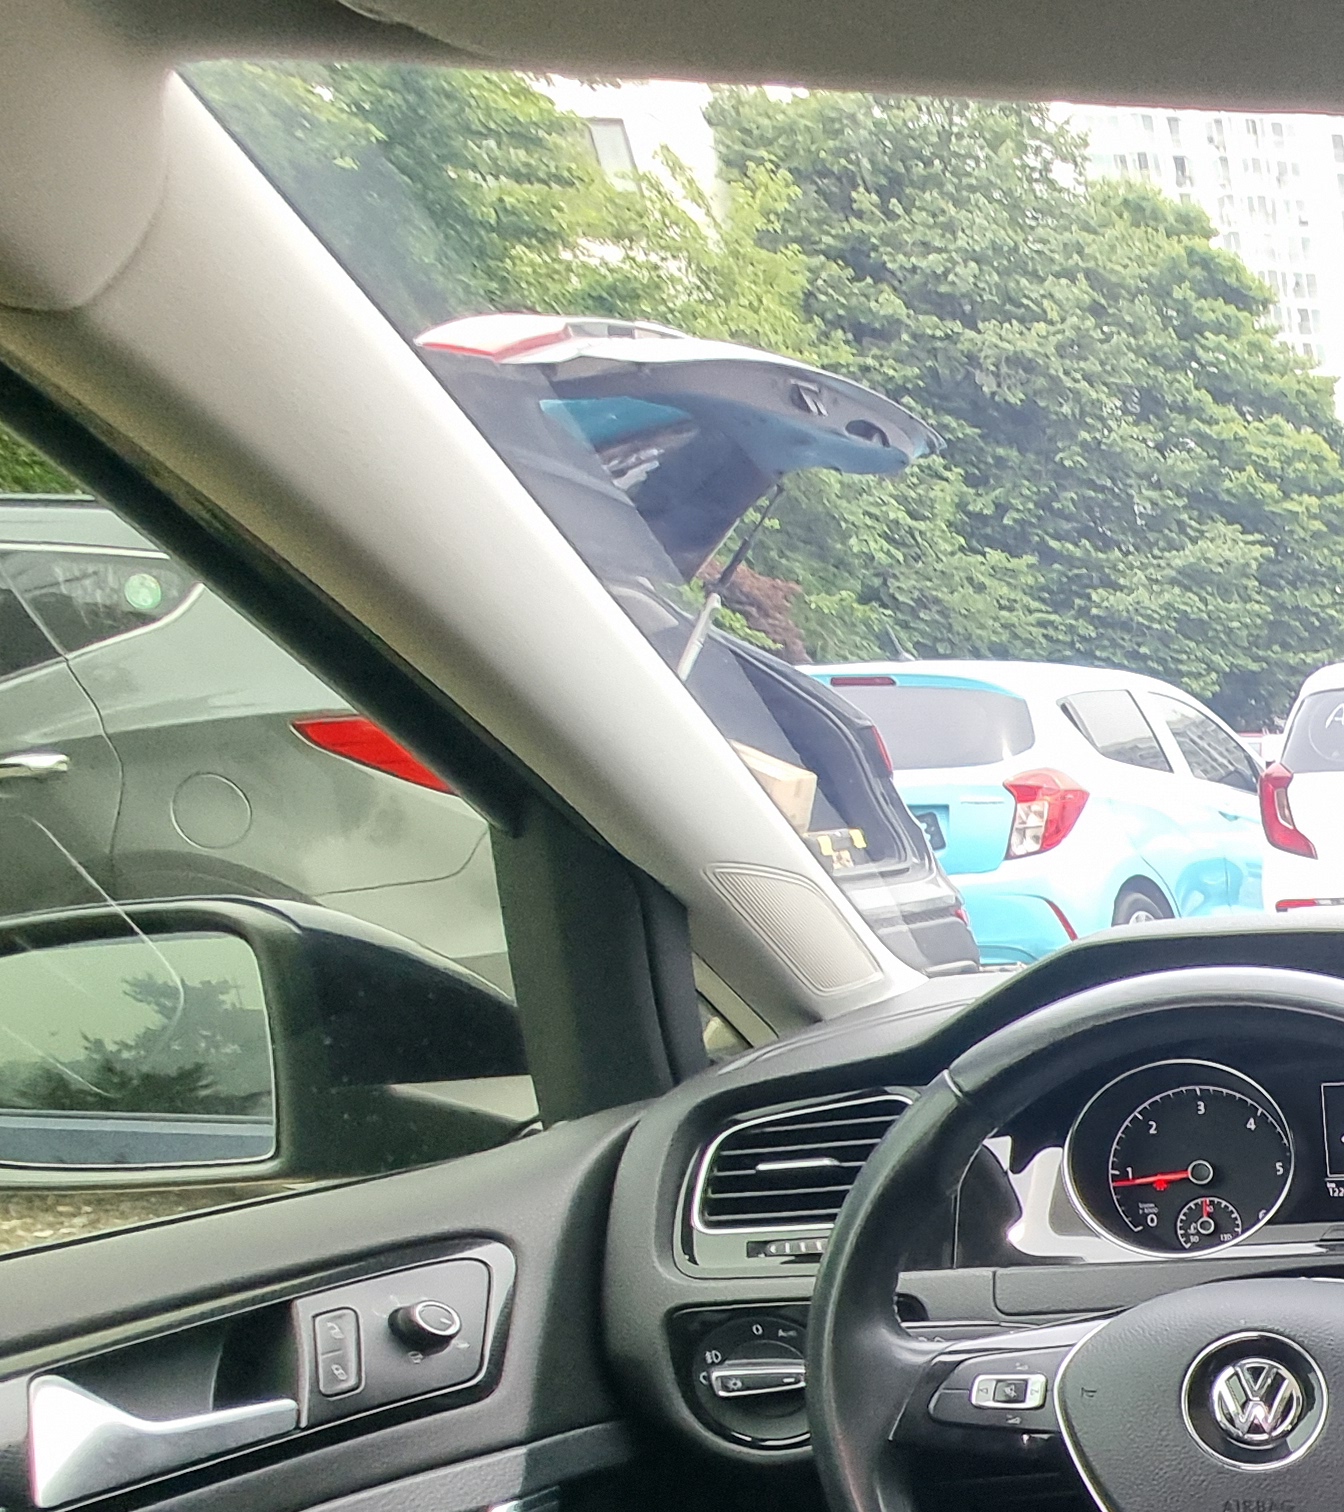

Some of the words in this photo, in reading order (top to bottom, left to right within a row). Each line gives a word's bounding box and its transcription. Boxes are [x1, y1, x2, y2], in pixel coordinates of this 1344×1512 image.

[1197, 1101, 1206, 1115] 3
[1148, 1120, 1158, 1134] 2
[1246, 1117, 1256, 1131] 4
[1125, 1166, 1133, 1180] 1
[1275, 1161, 1284, 1175] 5
[1146, 1213, 1158, 1227] 0
